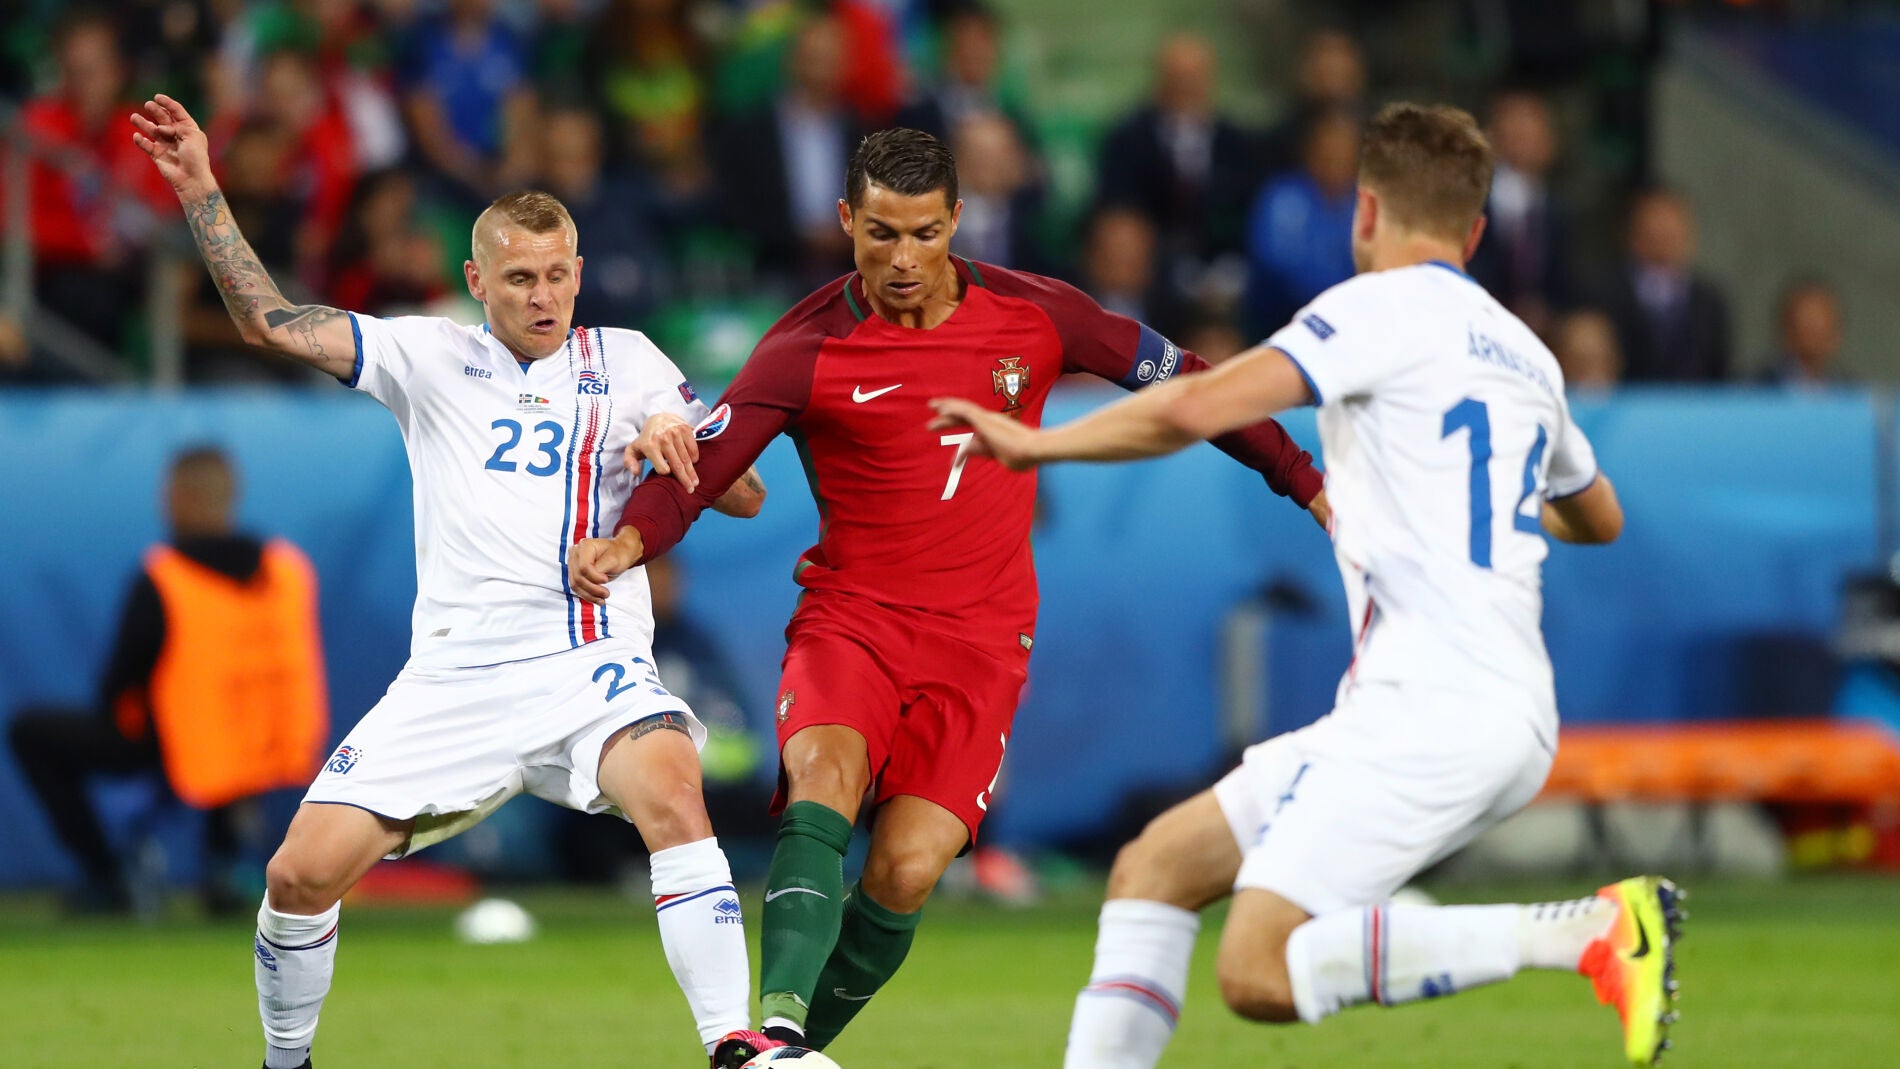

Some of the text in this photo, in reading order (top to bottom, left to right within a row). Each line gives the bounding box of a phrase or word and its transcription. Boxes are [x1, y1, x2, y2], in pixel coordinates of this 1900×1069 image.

[485, 418, 565, 477] 23
[940, 432, 974, 500] 7
[1441, 398, 1547, 569] 14
